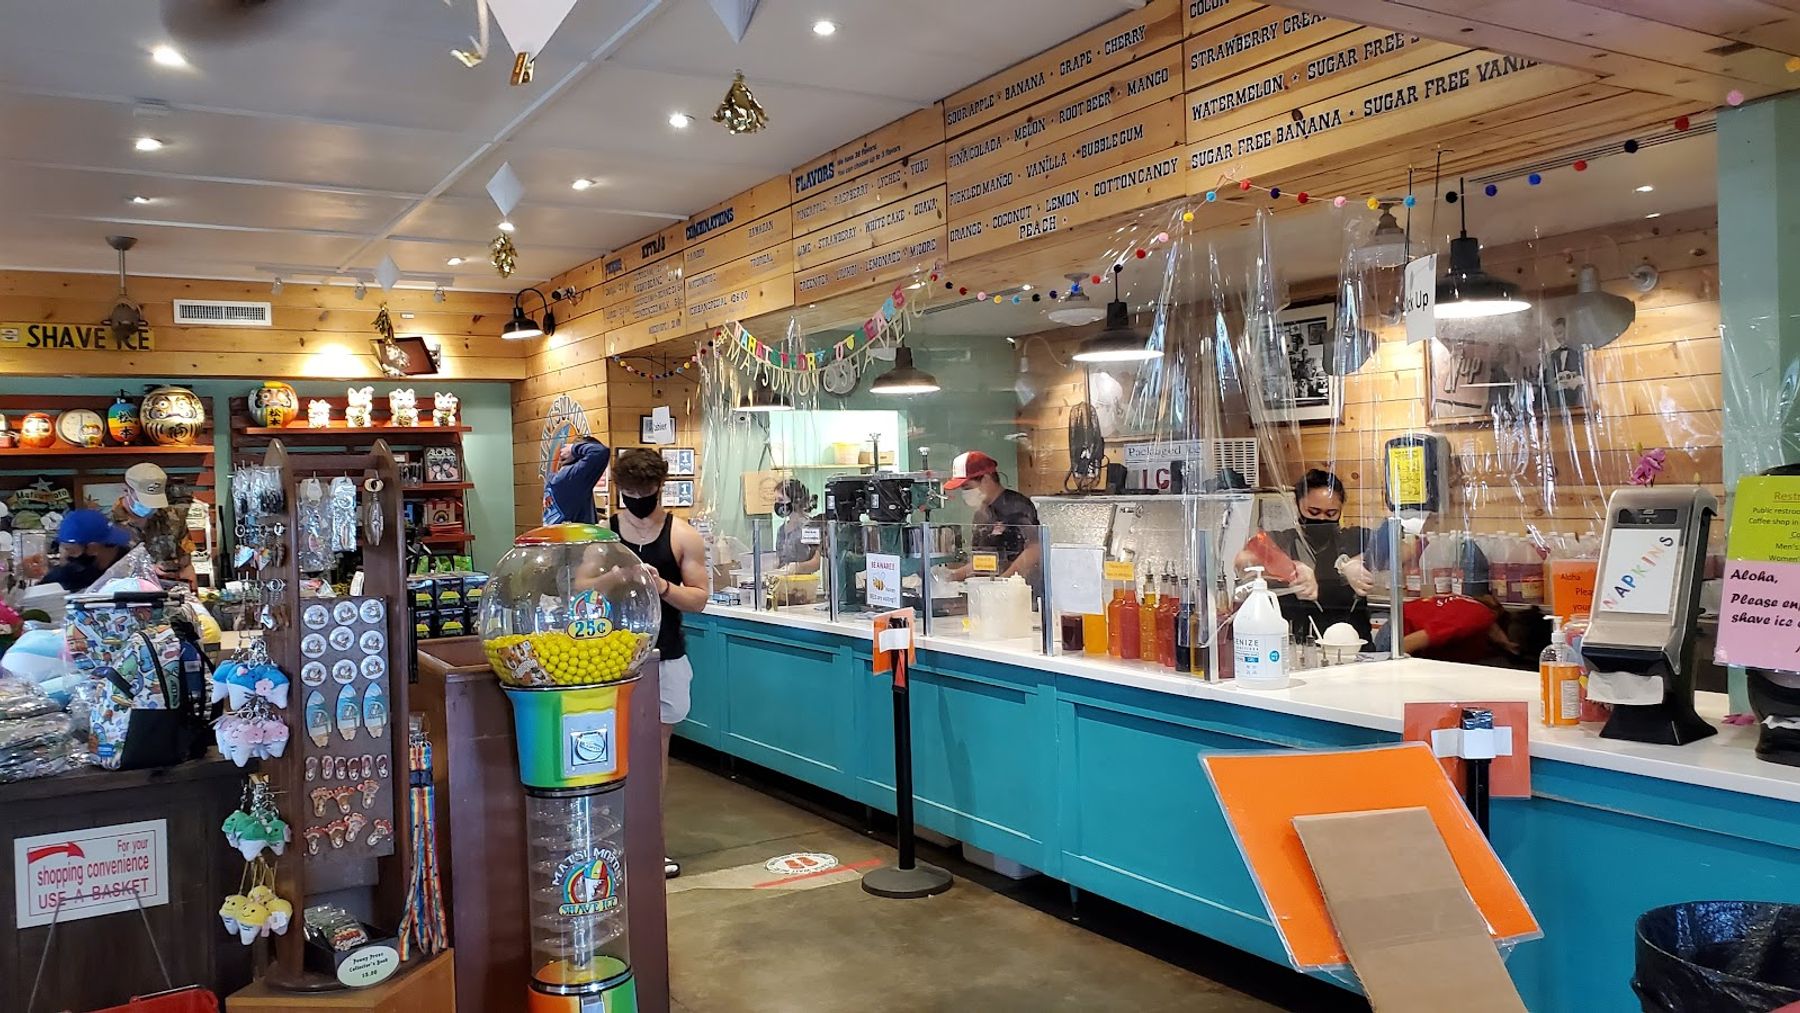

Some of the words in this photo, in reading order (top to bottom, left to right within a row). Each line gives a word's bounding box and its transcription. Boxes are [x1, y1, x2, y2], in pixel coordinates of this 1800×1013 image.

[1104, 25, 1146, 55] CHERRY
[1191, 23, 1278, 69] STRAWBERRY
[1283, 12, 1327, 34] CREA
[1060, 50, 1092, 76] GRAPE
[1308, 50, 1358, 80] SUGAR
[1364, 32, 1405, 60] FREE
[1005, 72, 1046, 100] BANANA
[1127, 67, 1169, 97] MANGO
[1364, 90, 1419, 117] SUGAR
[1425, 69, 1469, 98] FREE
[1476, 56, 1541, 82] VANIL
[947, 107, 968, 125] SOUR
[969, 94, 994, 116] APPLE
[1059, 103, 1085, 124] ROOT
[1086, 91, 1111, 114] BEER
[1192, 75, 1284, 121] WATERMELON
[1014, 118, 1046, 141] MELON
[1081, 134, 1118, 158] BUBBLE
[1119, 124, 1144, 145] GUM
[1191, 143, 1234, 169] SUGAR
[1238, 131, 1271, 155] FREE
[1276, 109, 1342, 143] BANANA
[969, 136, 1002, 160] COLADA
[1026, 153, 1067, 178] VANILLA
[795, 161, 835, 194] FLAVORS
[877, 170, 901, 190] LYCHEE
[982, 172, 1013, 195] MANGO
[1094, 171, 1137, 197] COTTON
[1138, 158, 1178, 183] CANDY
[913, 198, 937, 216] GUAVA
[1045, 190, 1080, 213] LEMON
[864, 215, 885, 233] WHITE
[887, 209, 905, 226] CAKE
[992, 206, 1032, 229] COCONUT
[1019, 216, 1057, 239] PEACH
[950, 222, 982, 242] ORANGE
[1415, 289, 1428, 311] Up
[27, 325, 106, 348] SHAVE
[1143, 468, 1170, 490] IC
[1748, 517, 1771, 525] Coffee
[1773, 518, 1790, 526] shop
[1768, 554, 1800, 563] Women'
[1561, 572, 1581, 581] Aloha
[1602, 536, 1674, 609] NAPKINS
[1730, 569, 1778, 584] Aloha,
[1576, 587, 1593, 596] Plea
[1730, 593, 1778, 608] Please
[1731, 612, 1770, 626] shave
[1774, 614, 1793, 627] ice
[117, 839, 129, 853] For
[133, 838, 149, 854] your
[37, 861, 84, 888] shopping
[87, 853, 149, 878] convenience
[38, 890, 66, 909] USE
[75, 888, 84, 903] A
[91, 877, 149, 901] BASKET
[561, 901, 599, 916] SHAVE
[602, 897, 616, 909] ICE
